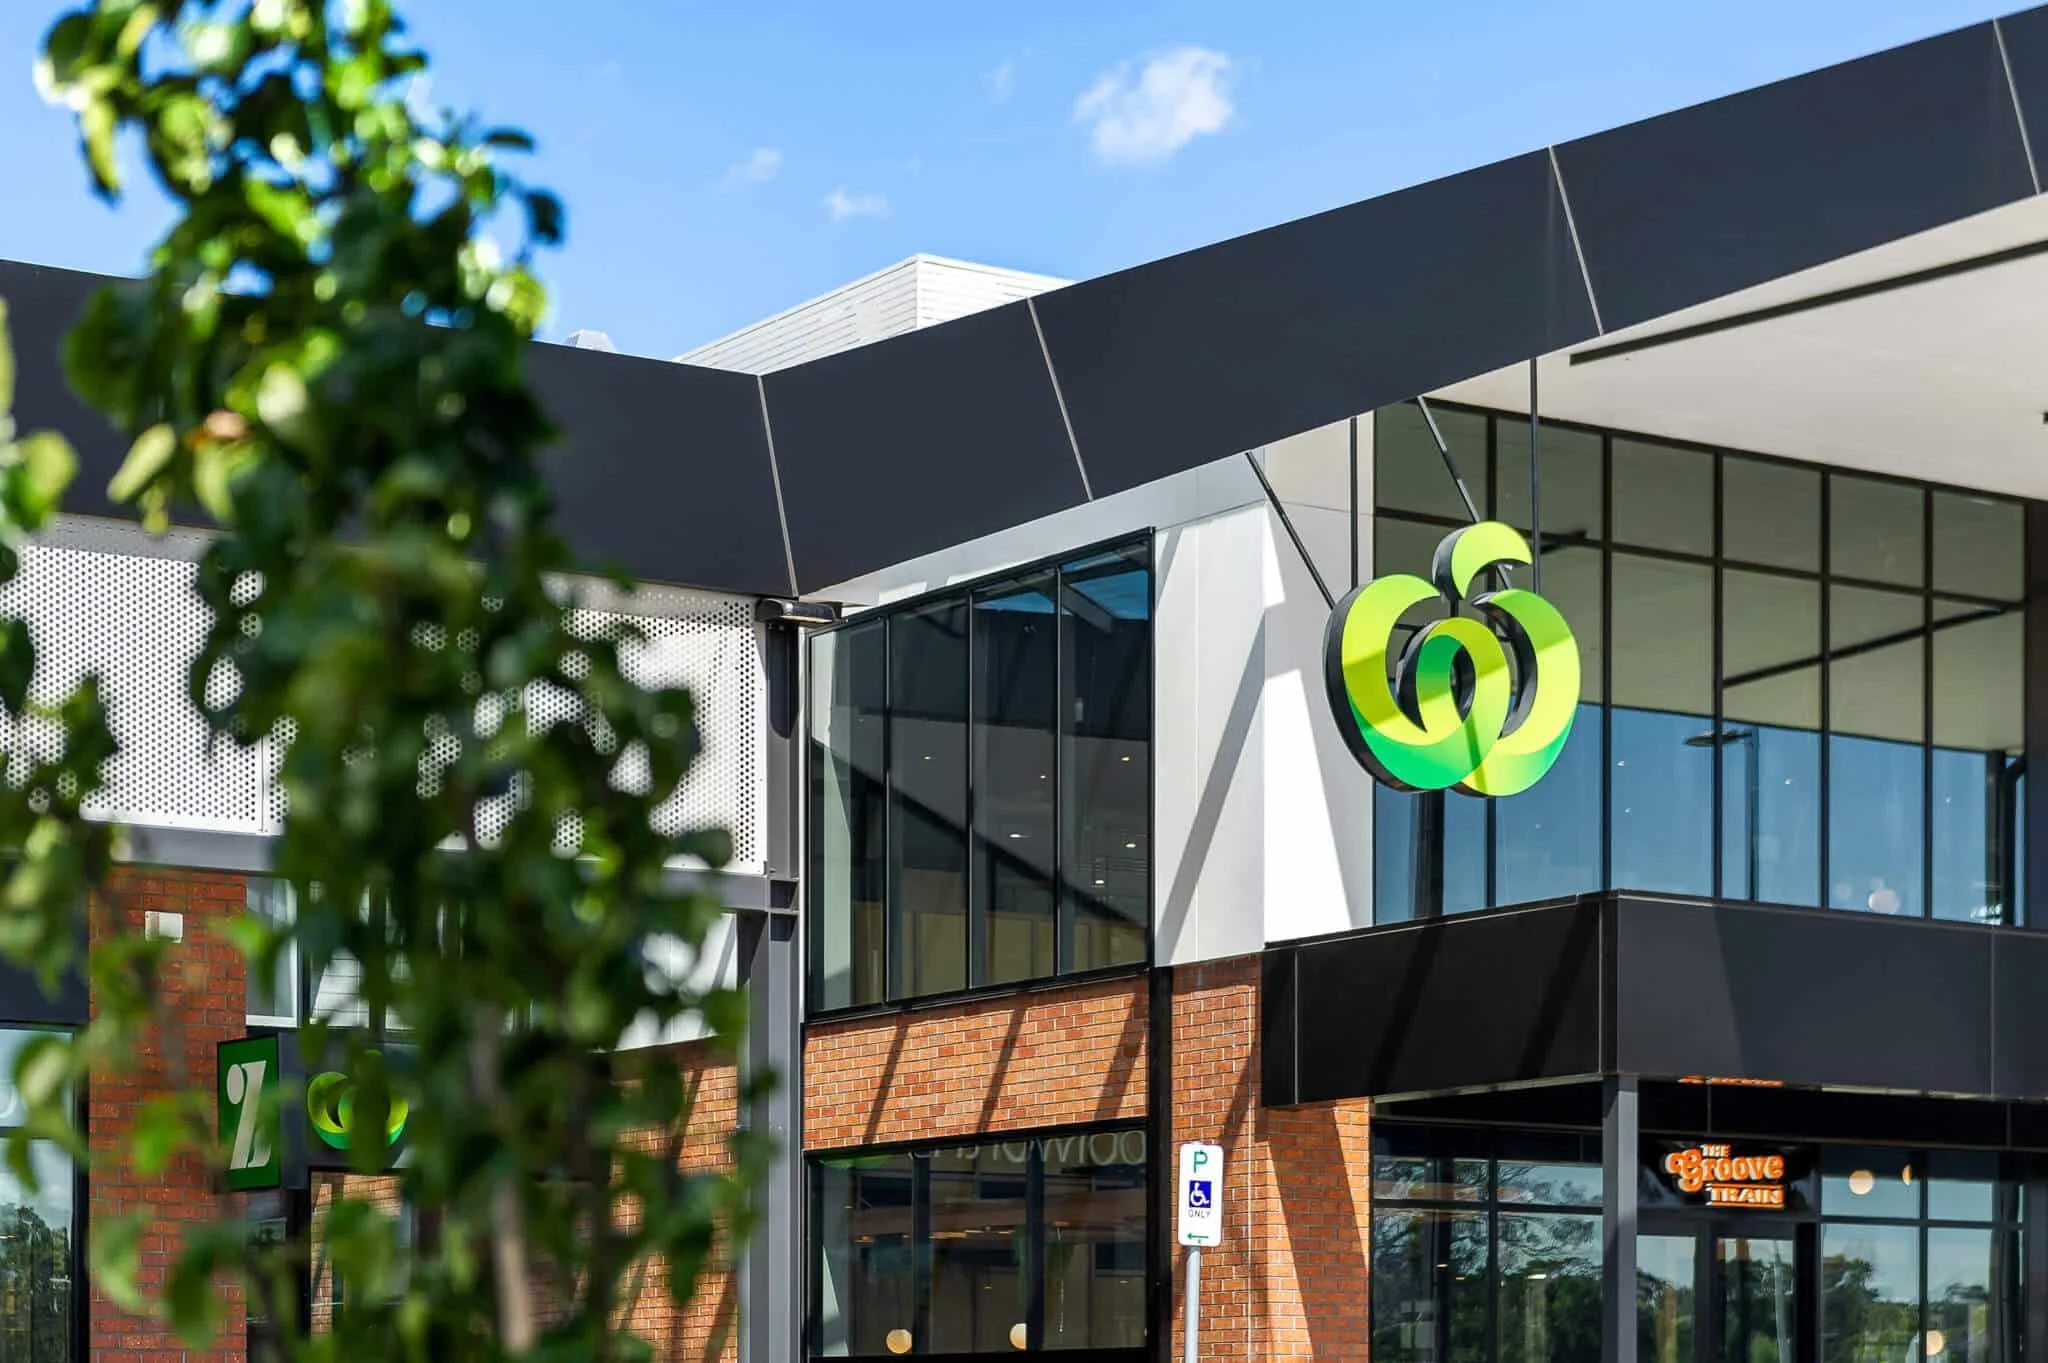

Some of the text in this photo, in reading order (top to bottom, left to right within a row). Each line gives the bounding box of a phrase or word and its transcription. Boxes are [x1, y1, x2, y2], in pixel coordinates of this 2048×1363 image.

[1700, 1144, 1731, 1157] THE
[1193, 1150, 1209, 1174] P
[1706, 1186, 1784, 1204] TRAIN
[1188, 1208, 1211, 1219] ONLY
